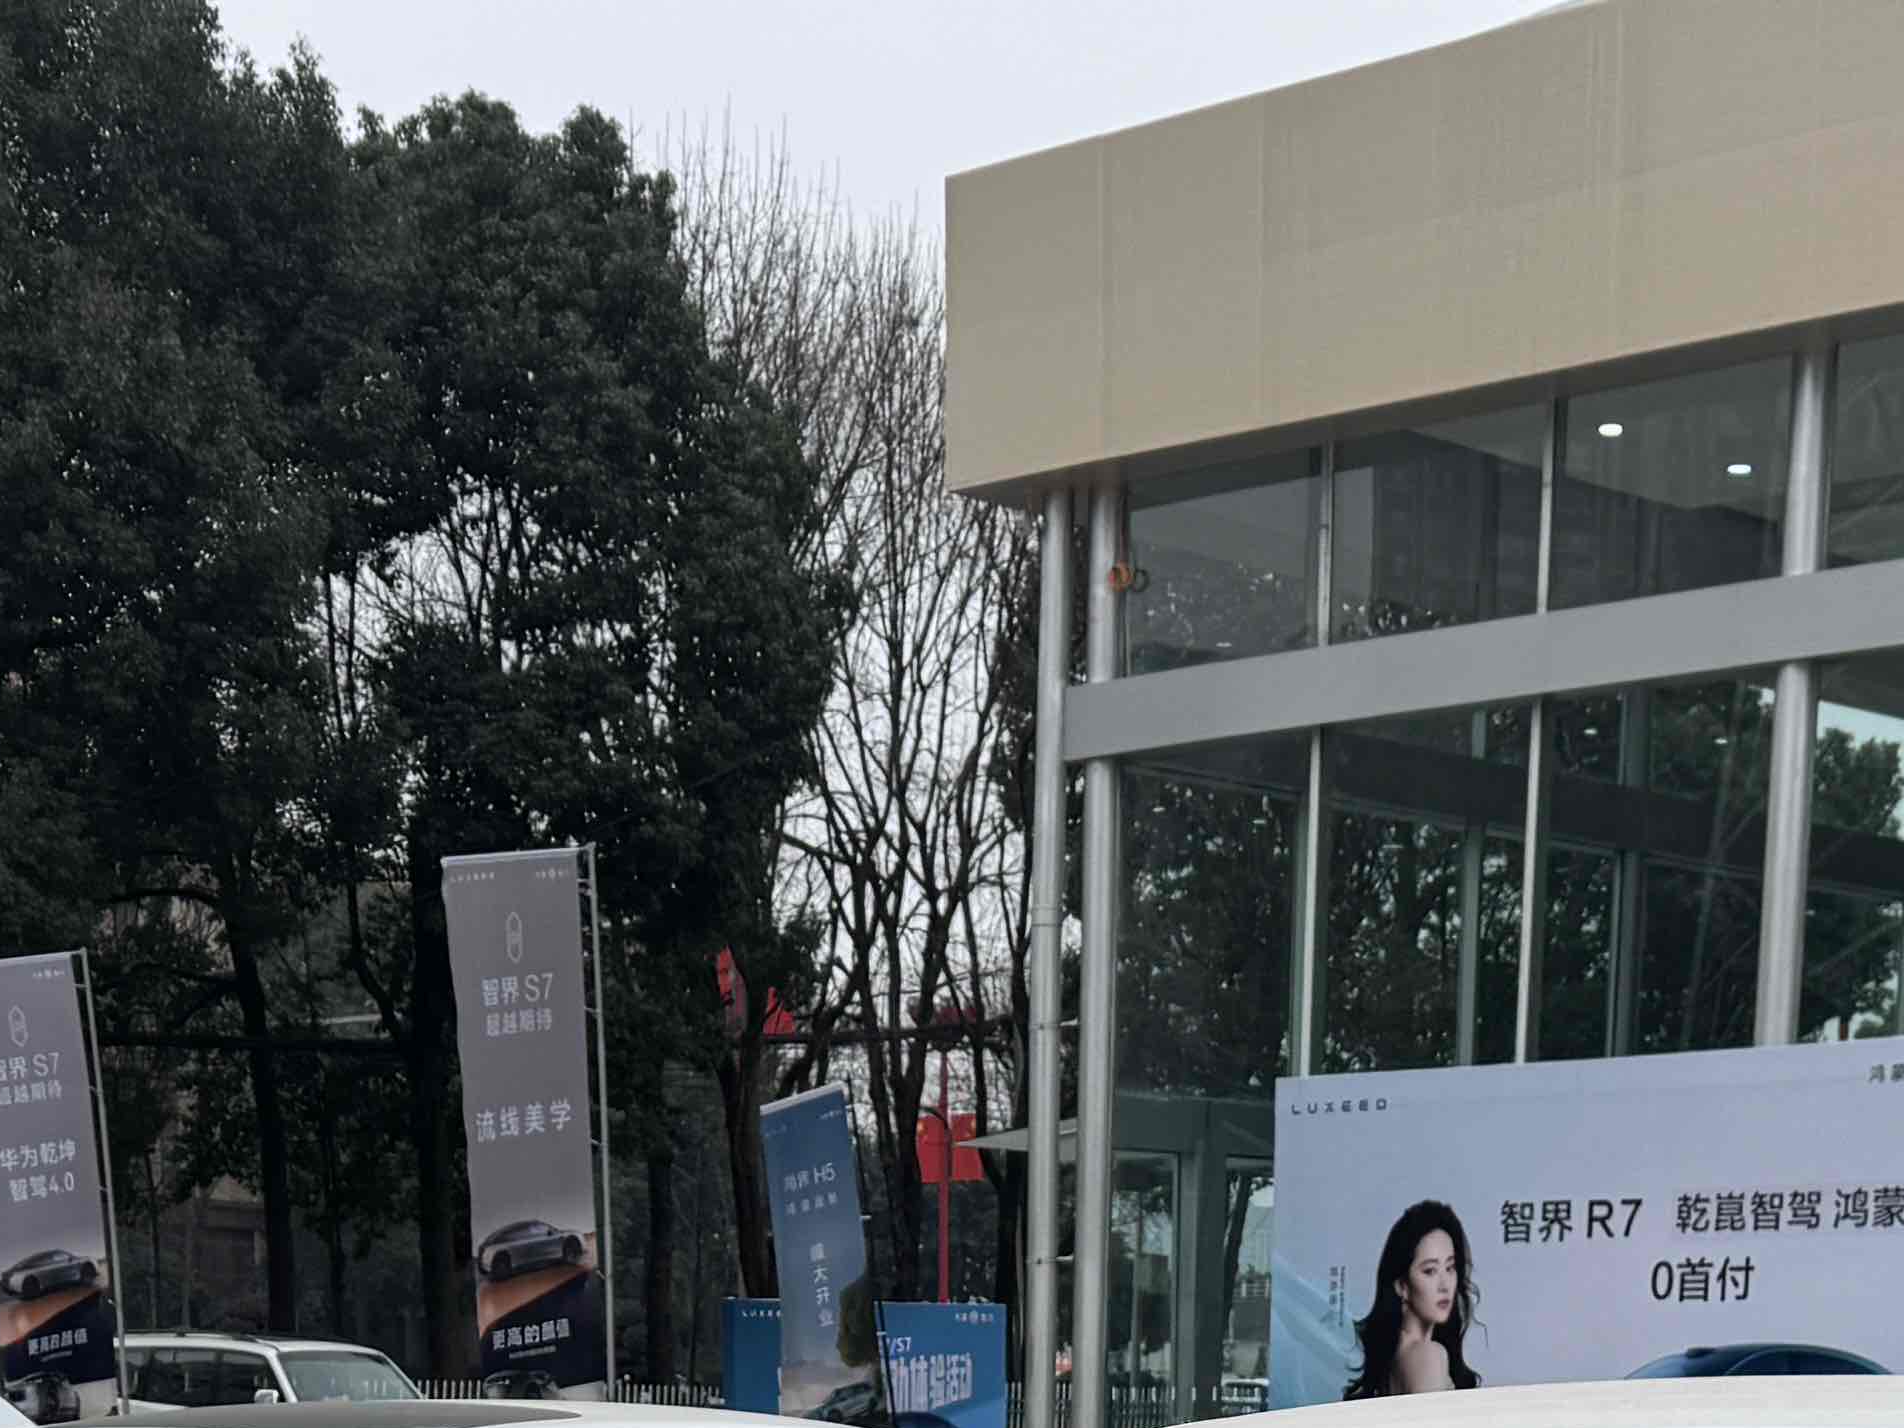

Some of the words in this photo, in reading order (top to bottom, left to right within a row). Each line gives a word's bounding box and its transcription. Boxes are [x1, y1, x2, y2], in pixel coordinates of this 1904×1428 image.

[524, 972, 554, 1003] S7
[32, 1051, 61, 1078] S7
[475, 1097, 571, 1144] 流线美学
[1291, 1098, 1388, 1116] LUXEED
[1499, 1200, 1574, 1245] 智界
[1585, 1199, 1644, 1240] R7
[1674, 1190, 1823, 1236] 乾崑智驾
[1650, 1255, 1756, 1304] 0首付
